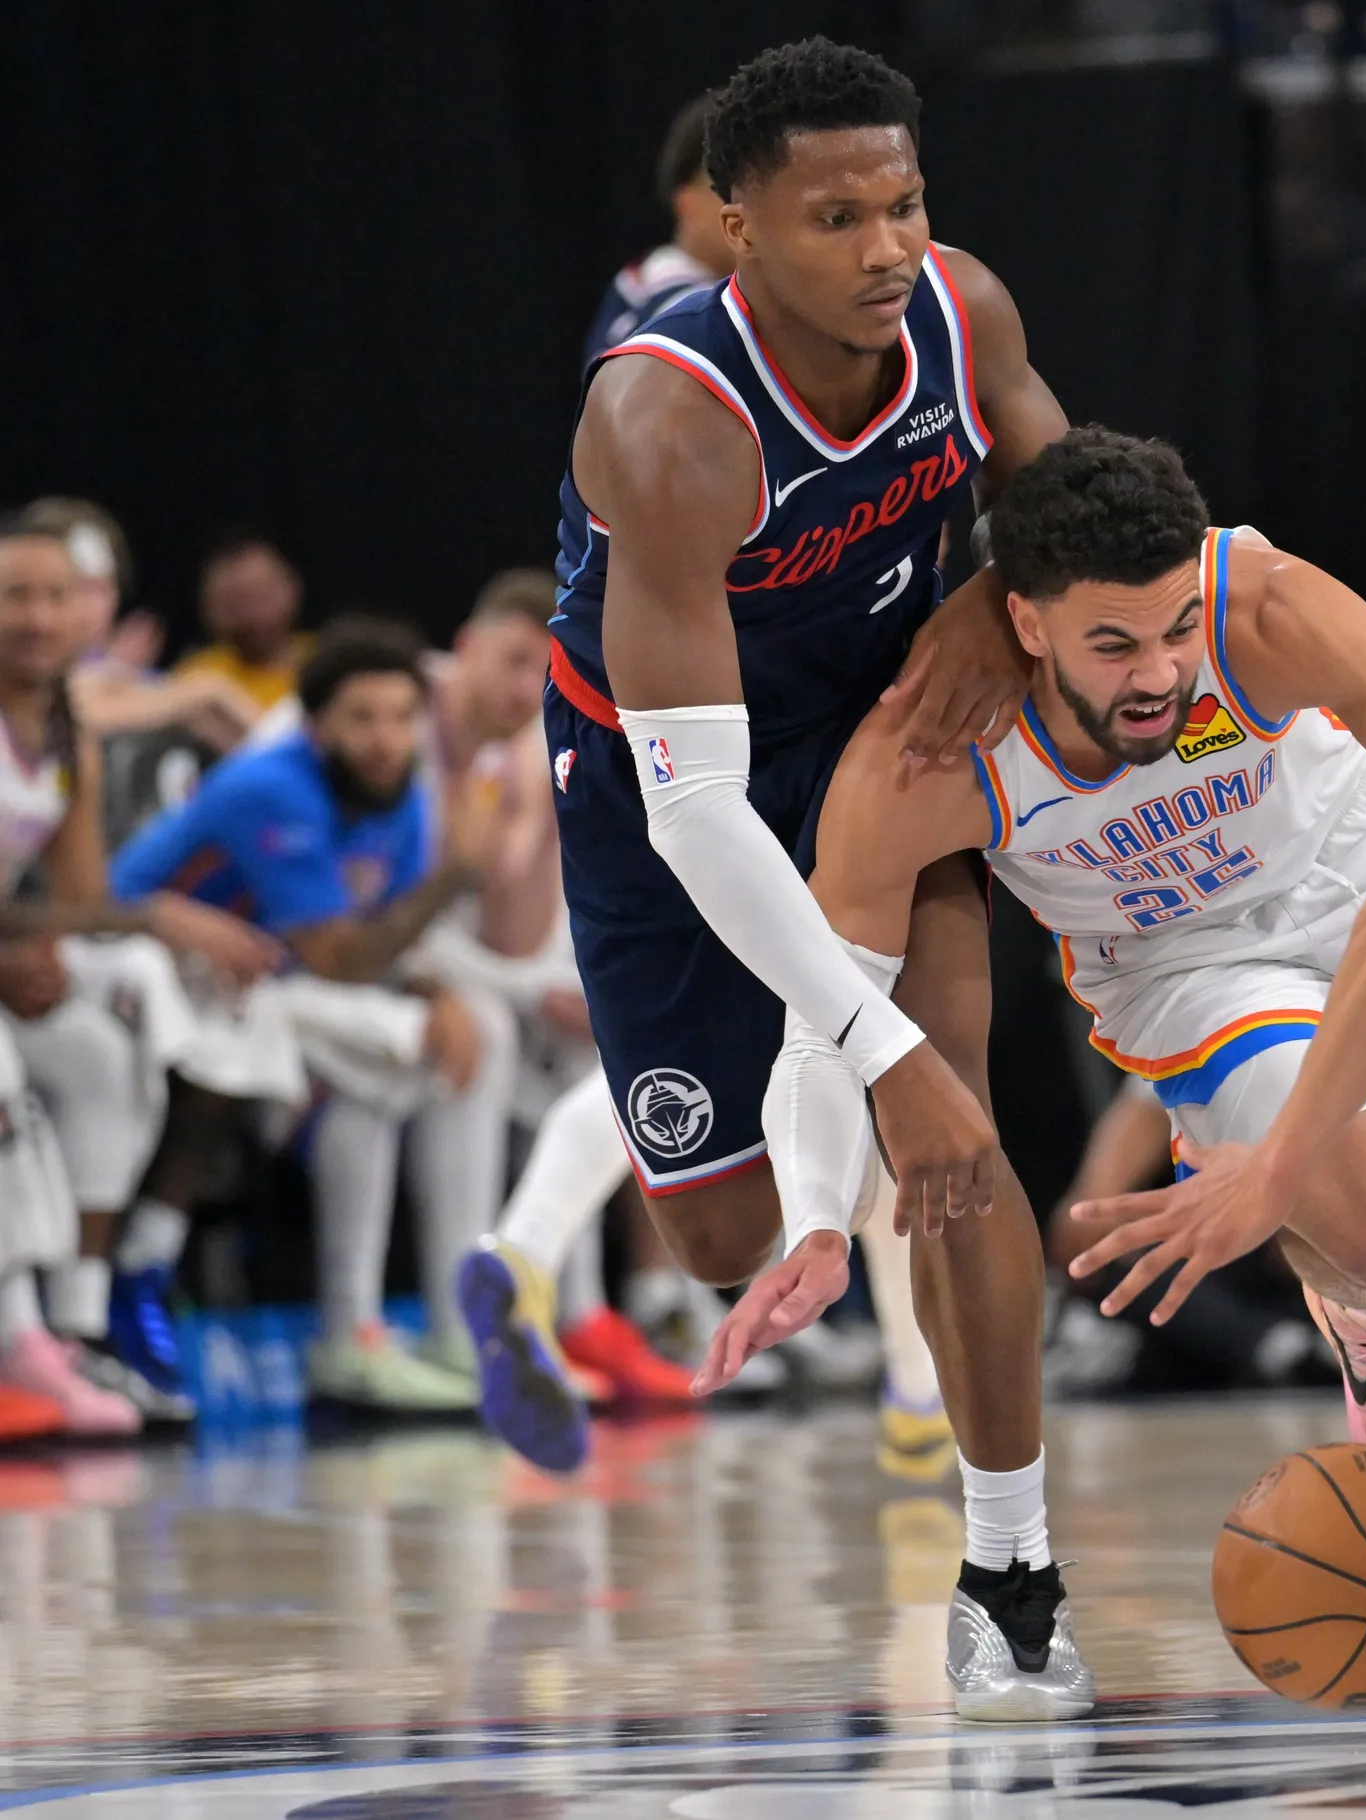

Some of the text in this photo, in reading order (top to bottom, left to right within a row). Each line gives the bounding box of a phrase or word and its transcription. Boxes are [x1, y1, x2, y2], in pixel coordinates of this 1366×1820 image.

[897, 408, 955, 449] RWANDA
[909, 402, 946, 429] VISIT
[725, 434, 968, 593] Clippers
[1025, 748, 1277, 871] KLAHOMA
[1101, 827, 1229, 883] CITY
